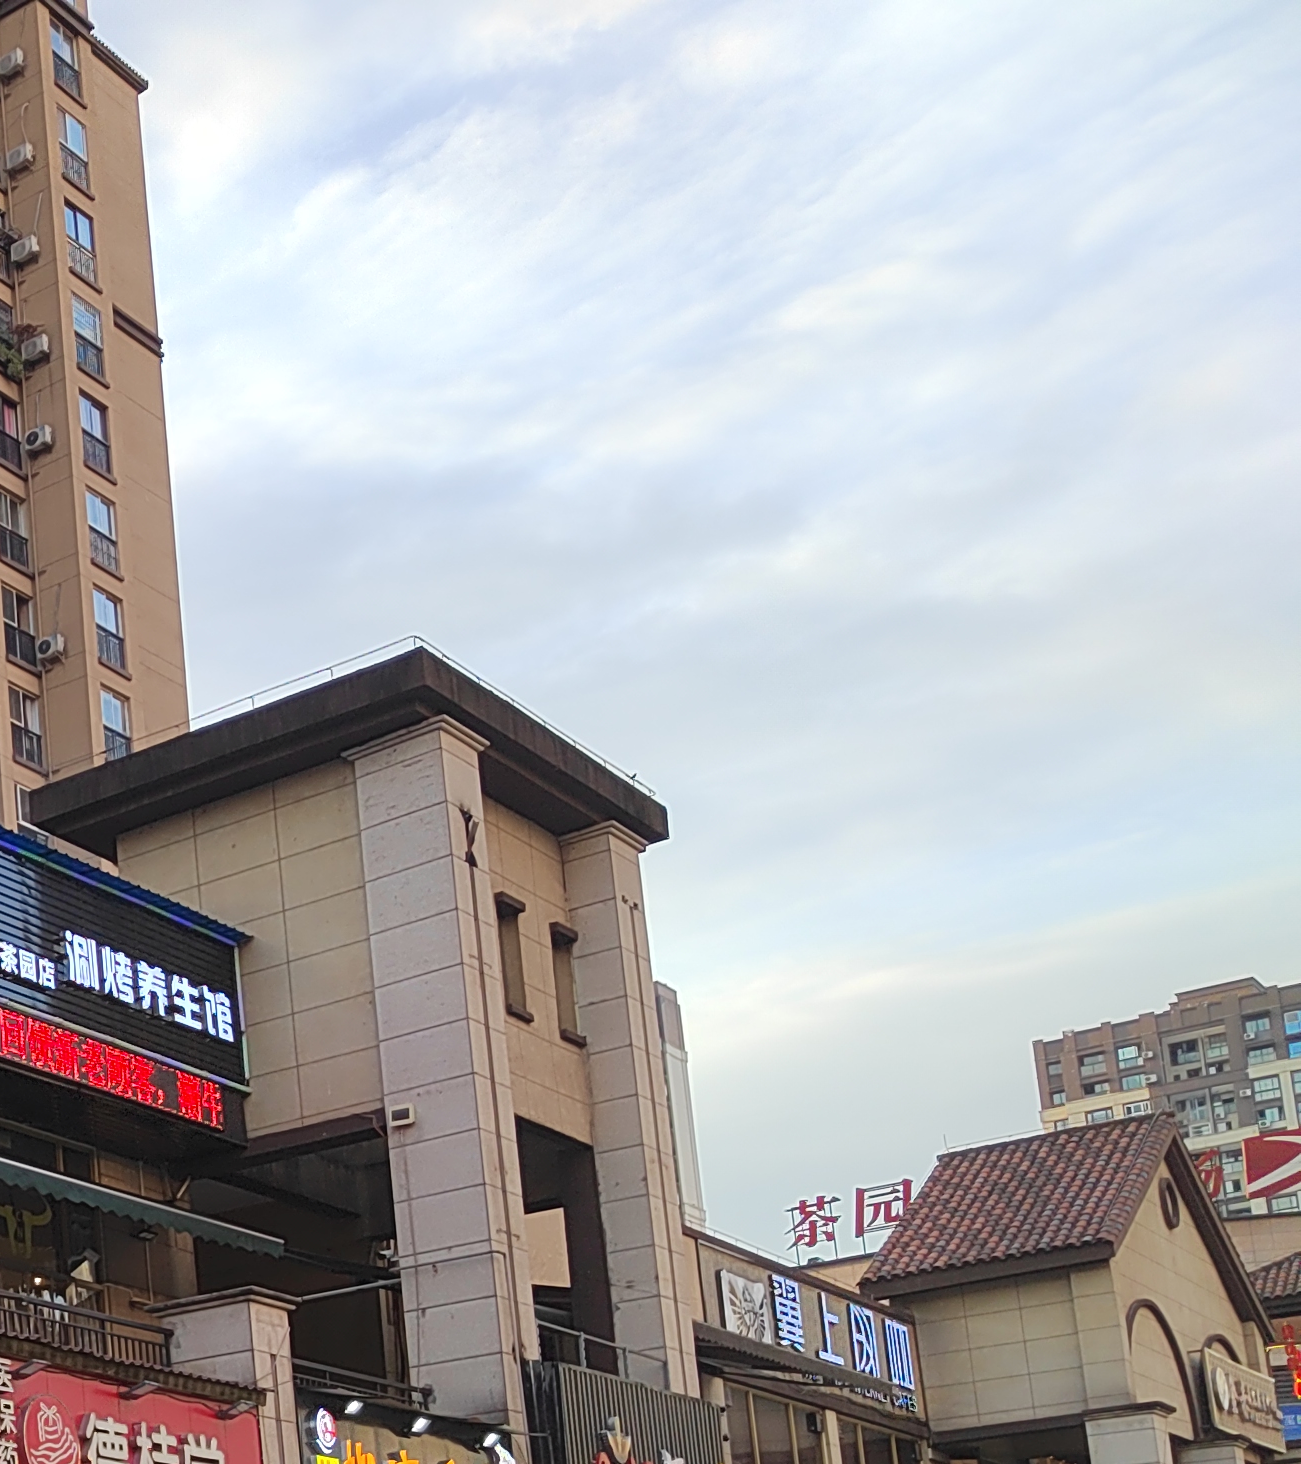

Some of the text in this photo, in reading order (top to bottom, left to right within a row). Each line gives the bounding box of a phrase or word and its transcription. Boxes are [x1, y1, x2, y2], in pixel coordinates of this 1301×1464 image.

[64, 929, 235, 1043] 涮烤养生馆
[786, 1178, 913, 1250] 茶园
